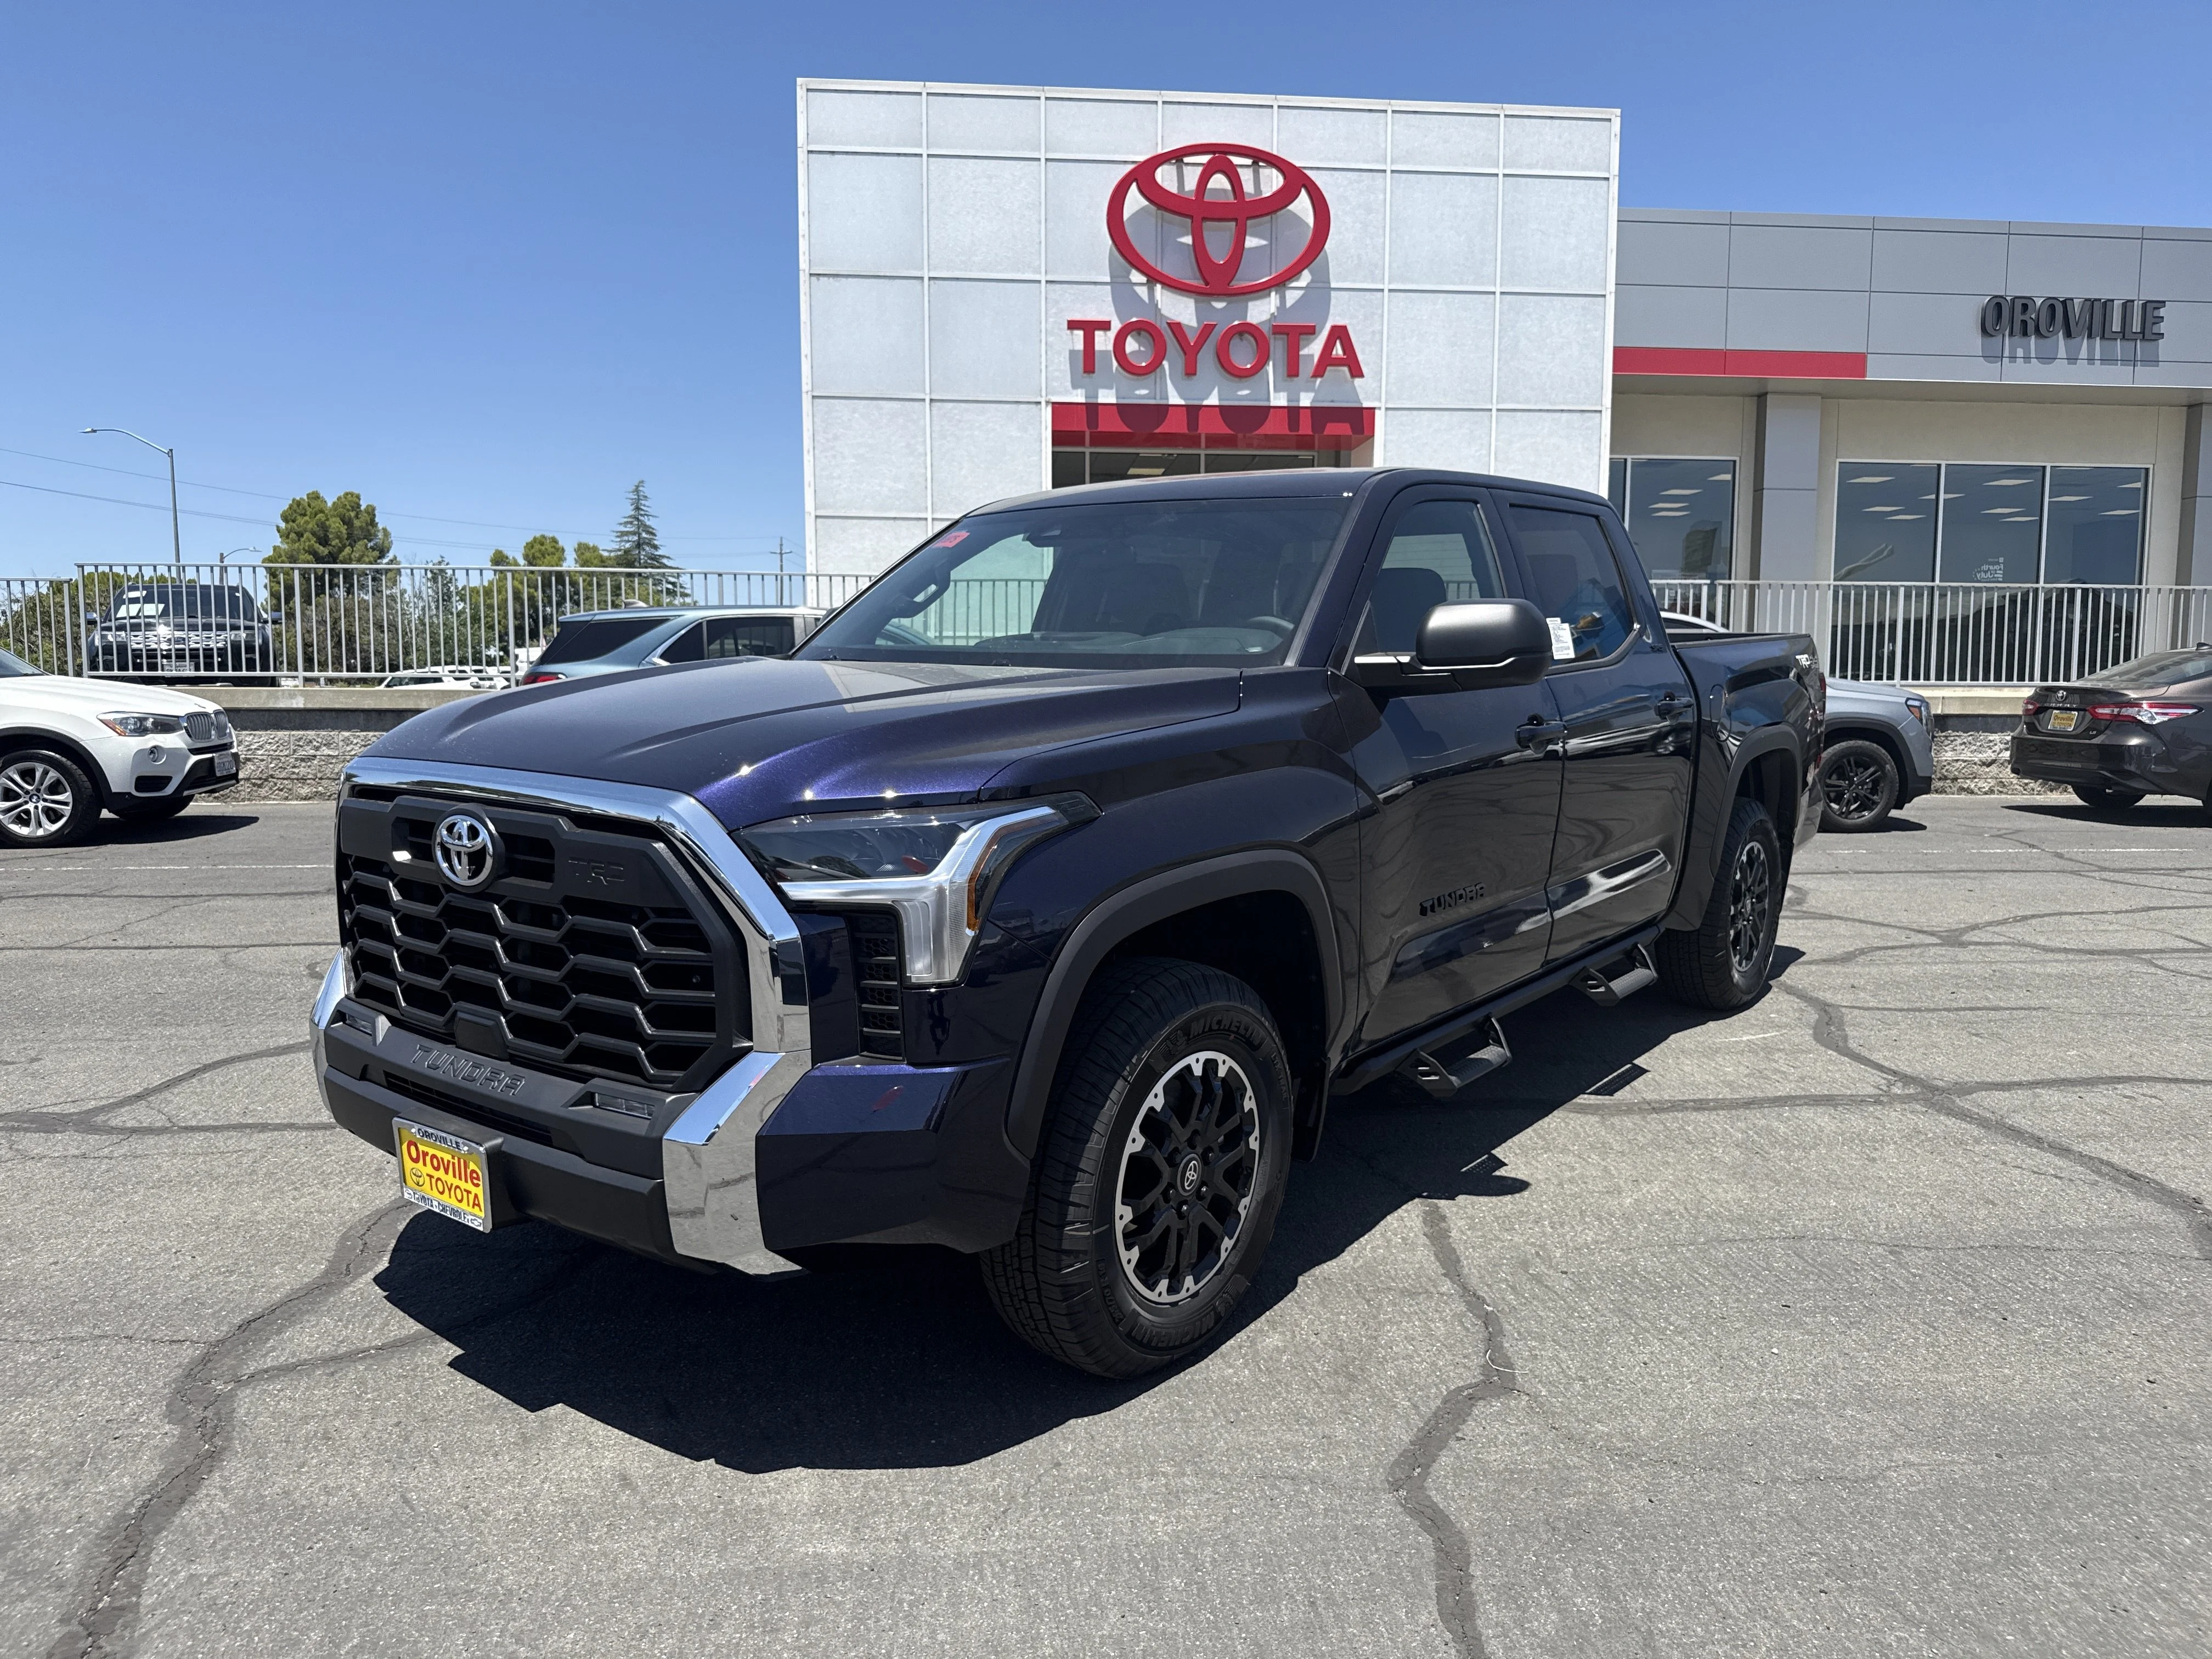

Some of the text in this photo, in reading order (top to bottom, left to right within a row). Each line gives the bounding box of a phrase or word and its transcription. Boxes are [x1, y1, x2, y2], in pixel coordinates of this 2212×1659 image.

[1981, 296, 2166, 341] OROVILLE
[1067, 318, 1365, 378] TOYOTA
[1795, 654, 1810, 669] TRD
[1419, 882, 1486, 917] TUNDRA
[1190, 1014, 1263, 1047] MICHELIN
[410, 1044, 526, 1096] TUNDRA
[417, 1128, 462, 1151] OROVILLE
[407, 1140, 481, 1188] Oroville
[413, 1192, 434, 1208] TOYOTA
[426, 1173, 482, 1212] TOYOTA
[1130, 1310, 1216, 1347] MICHELIN
